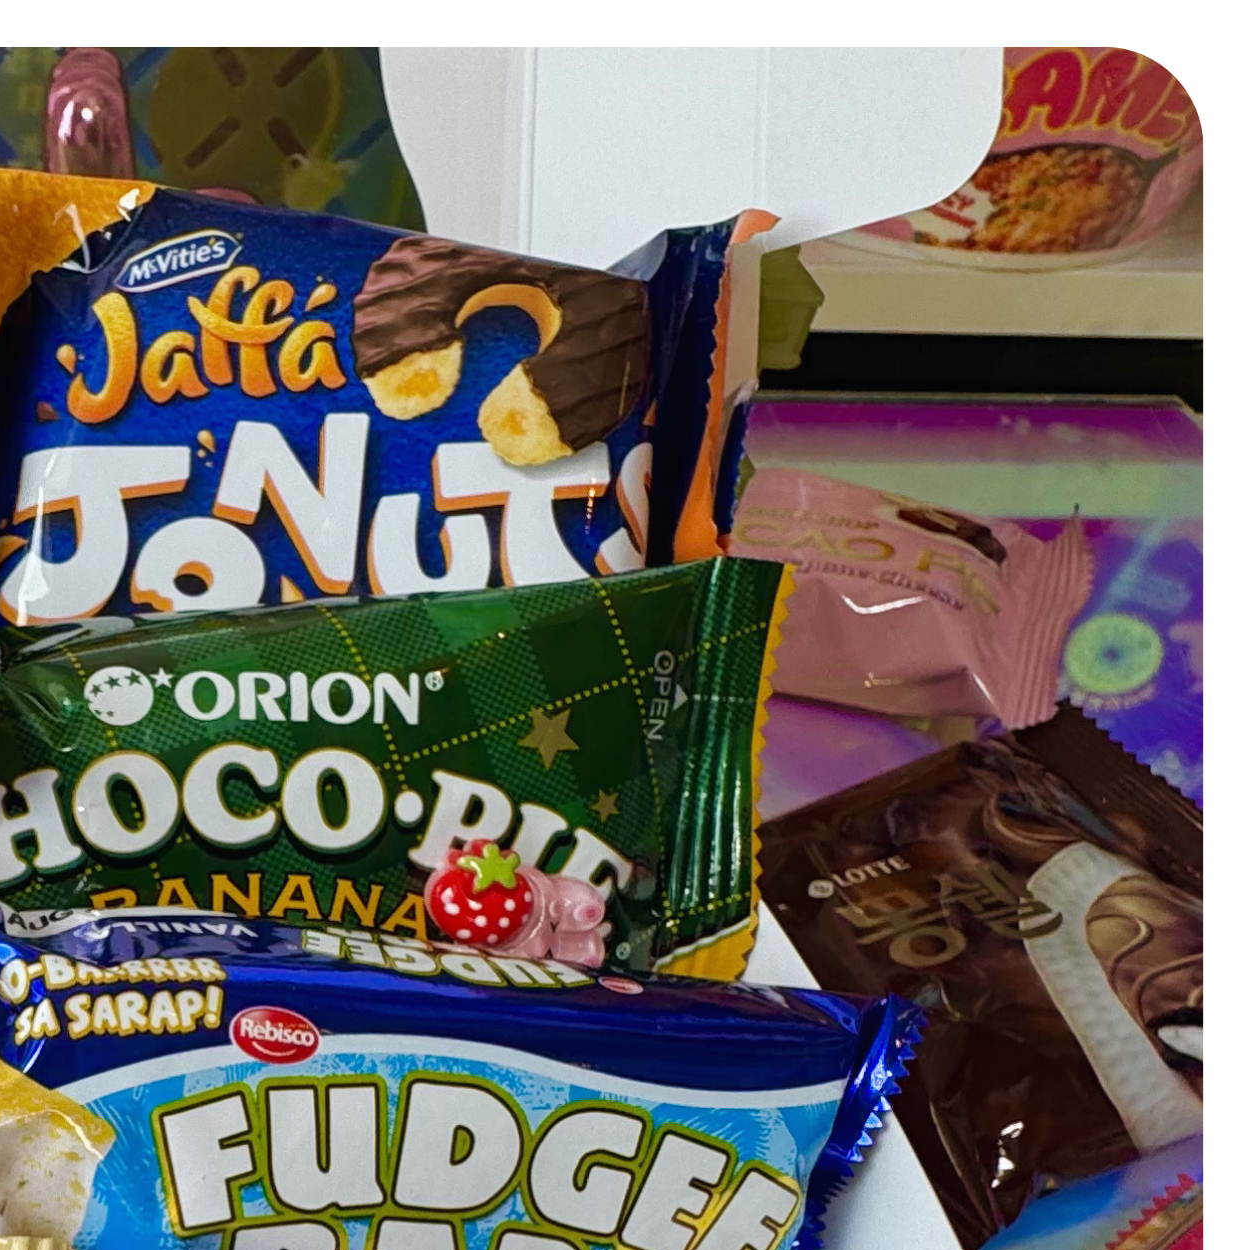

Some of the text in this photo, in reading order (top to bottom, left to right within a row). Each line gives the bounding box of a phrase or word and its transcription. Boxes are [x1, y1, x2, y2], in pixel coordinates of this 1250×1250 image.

[128, 239, 226, 287] McVitie's
[174, 671, 419, 726] ORION
[648, 649, 676, 742] OPEN
[831, 855, 911, 888] LOTTE
[14, 983, 225, 1047] SA SARAP!
[239, 1016, 316, 1048] Rebisco
